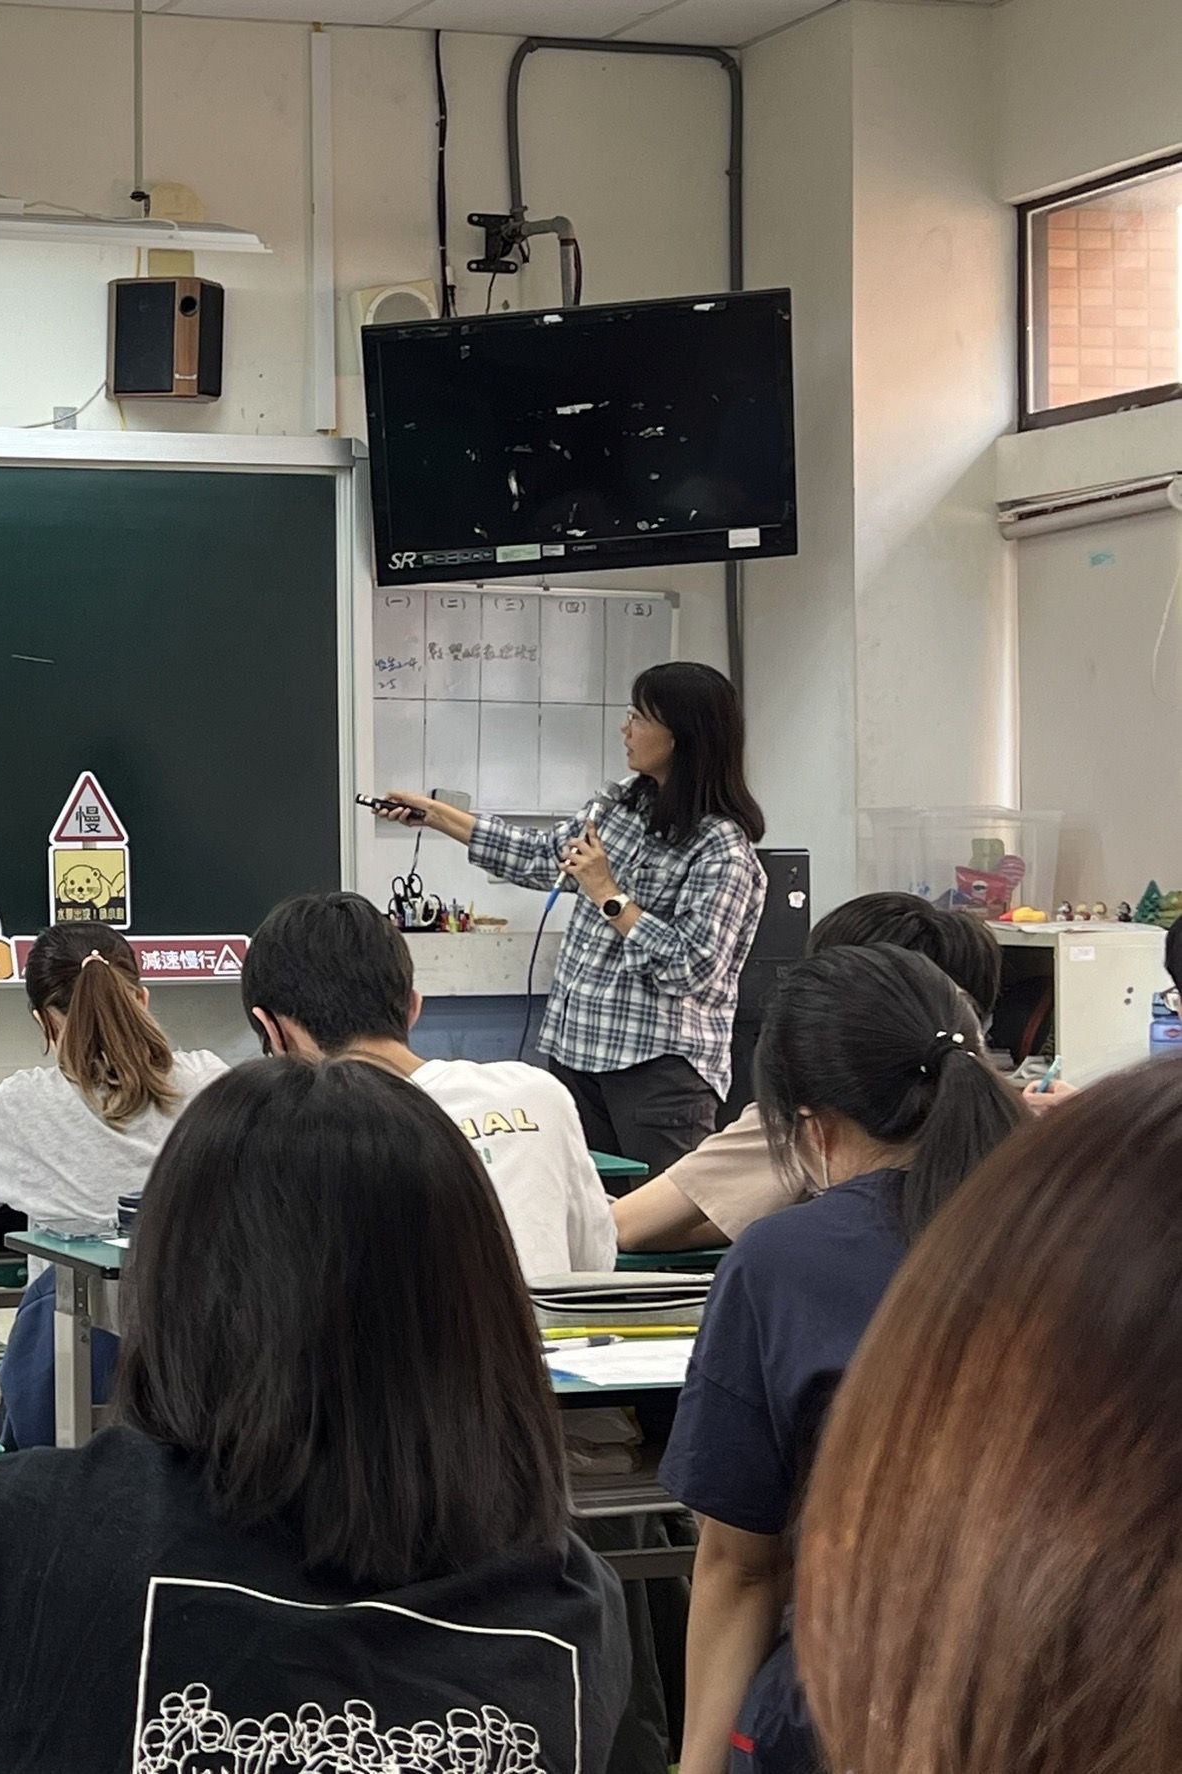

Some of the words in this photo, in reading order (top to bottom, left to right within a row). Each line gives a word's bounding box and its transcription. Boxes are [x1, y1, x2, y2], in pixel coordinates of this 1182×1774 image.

[75, 805, 103, 834] 慢
[141, 950, 216, 970] 減速慢行
